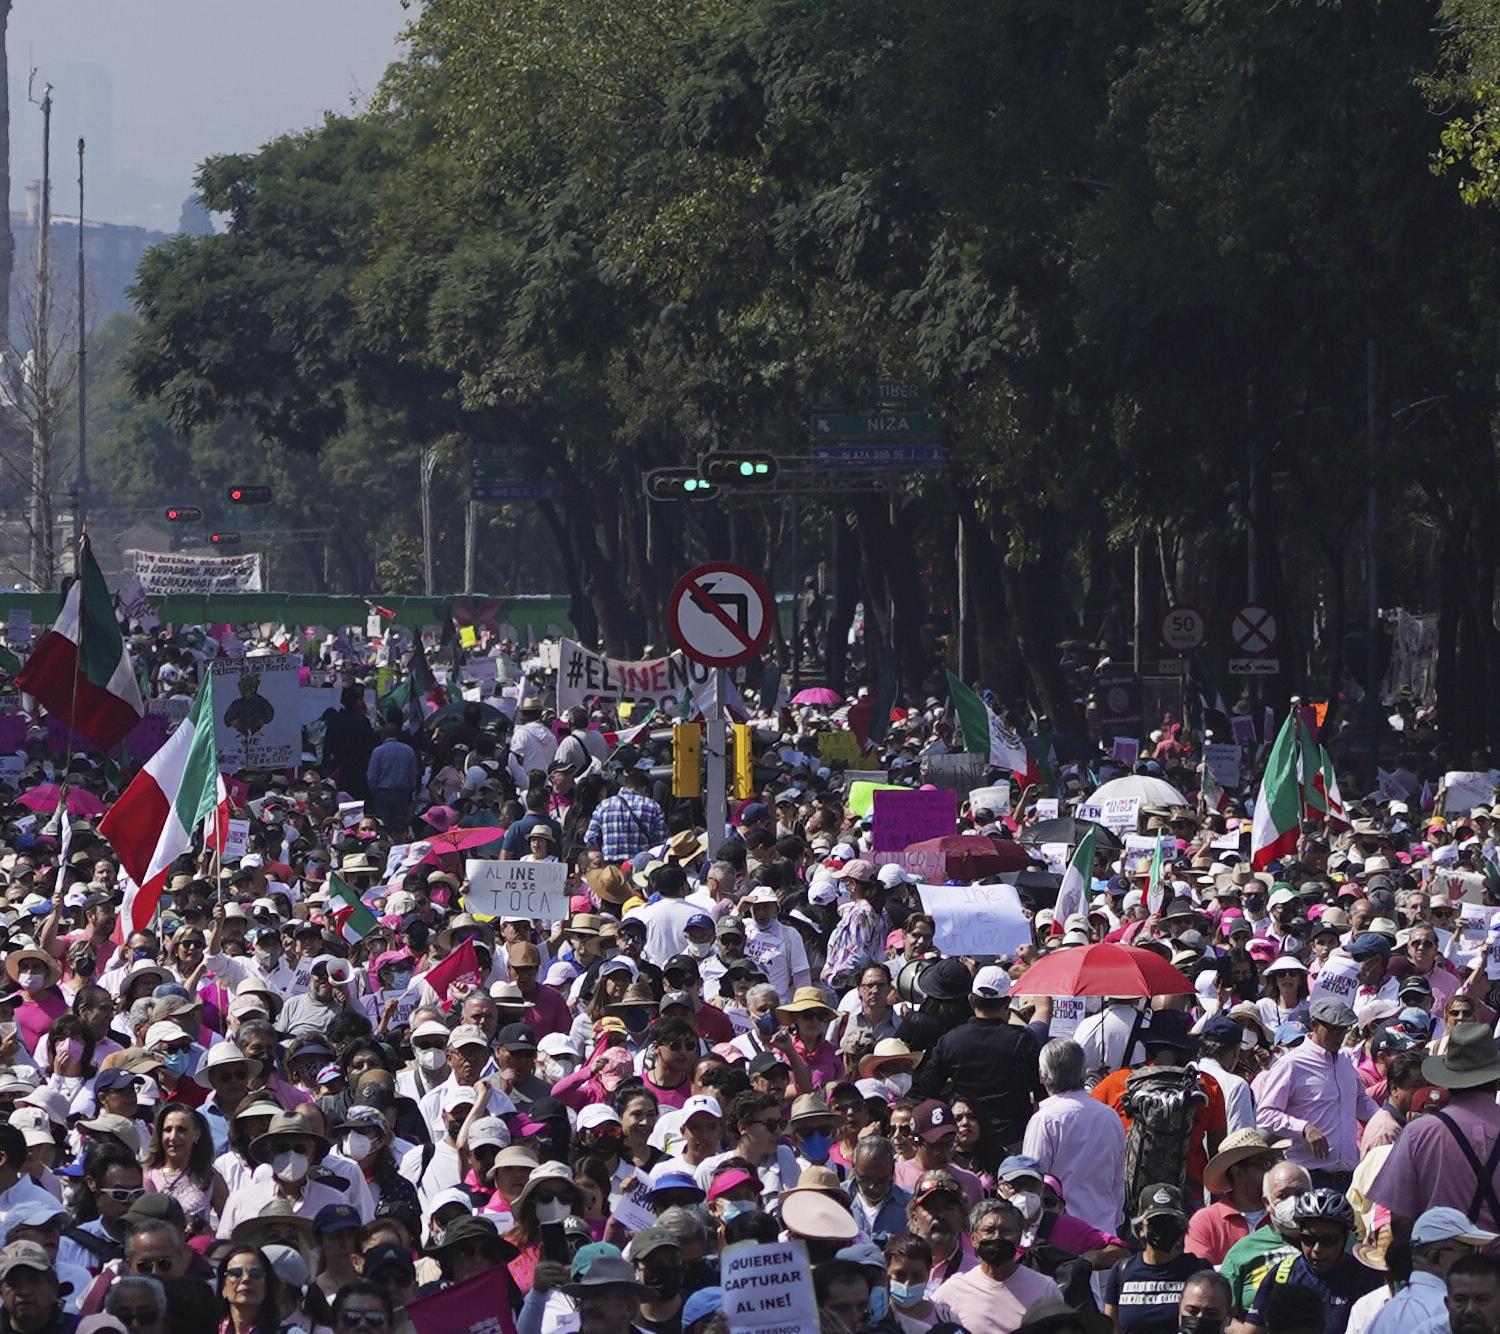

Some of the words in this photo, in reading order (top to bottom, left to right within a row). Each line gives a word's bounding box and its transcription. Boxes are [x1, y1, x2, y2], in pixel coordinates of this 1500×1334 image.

[867, 417, 910, 432] NIZA
[1169, 617, 1191, 632] 50
[484, 867, 502, 881] AL
[508, 866, 535, 881] INE
[488, 890, 550, 914] TOCA
[728, 1251, 793, 1275] ¡QUIEREN
[724, 1269, 802, 1292] CAPTURAR
[736, 1299, 760, 1314] AL
[760, 1293, 792, 1308] INE!
